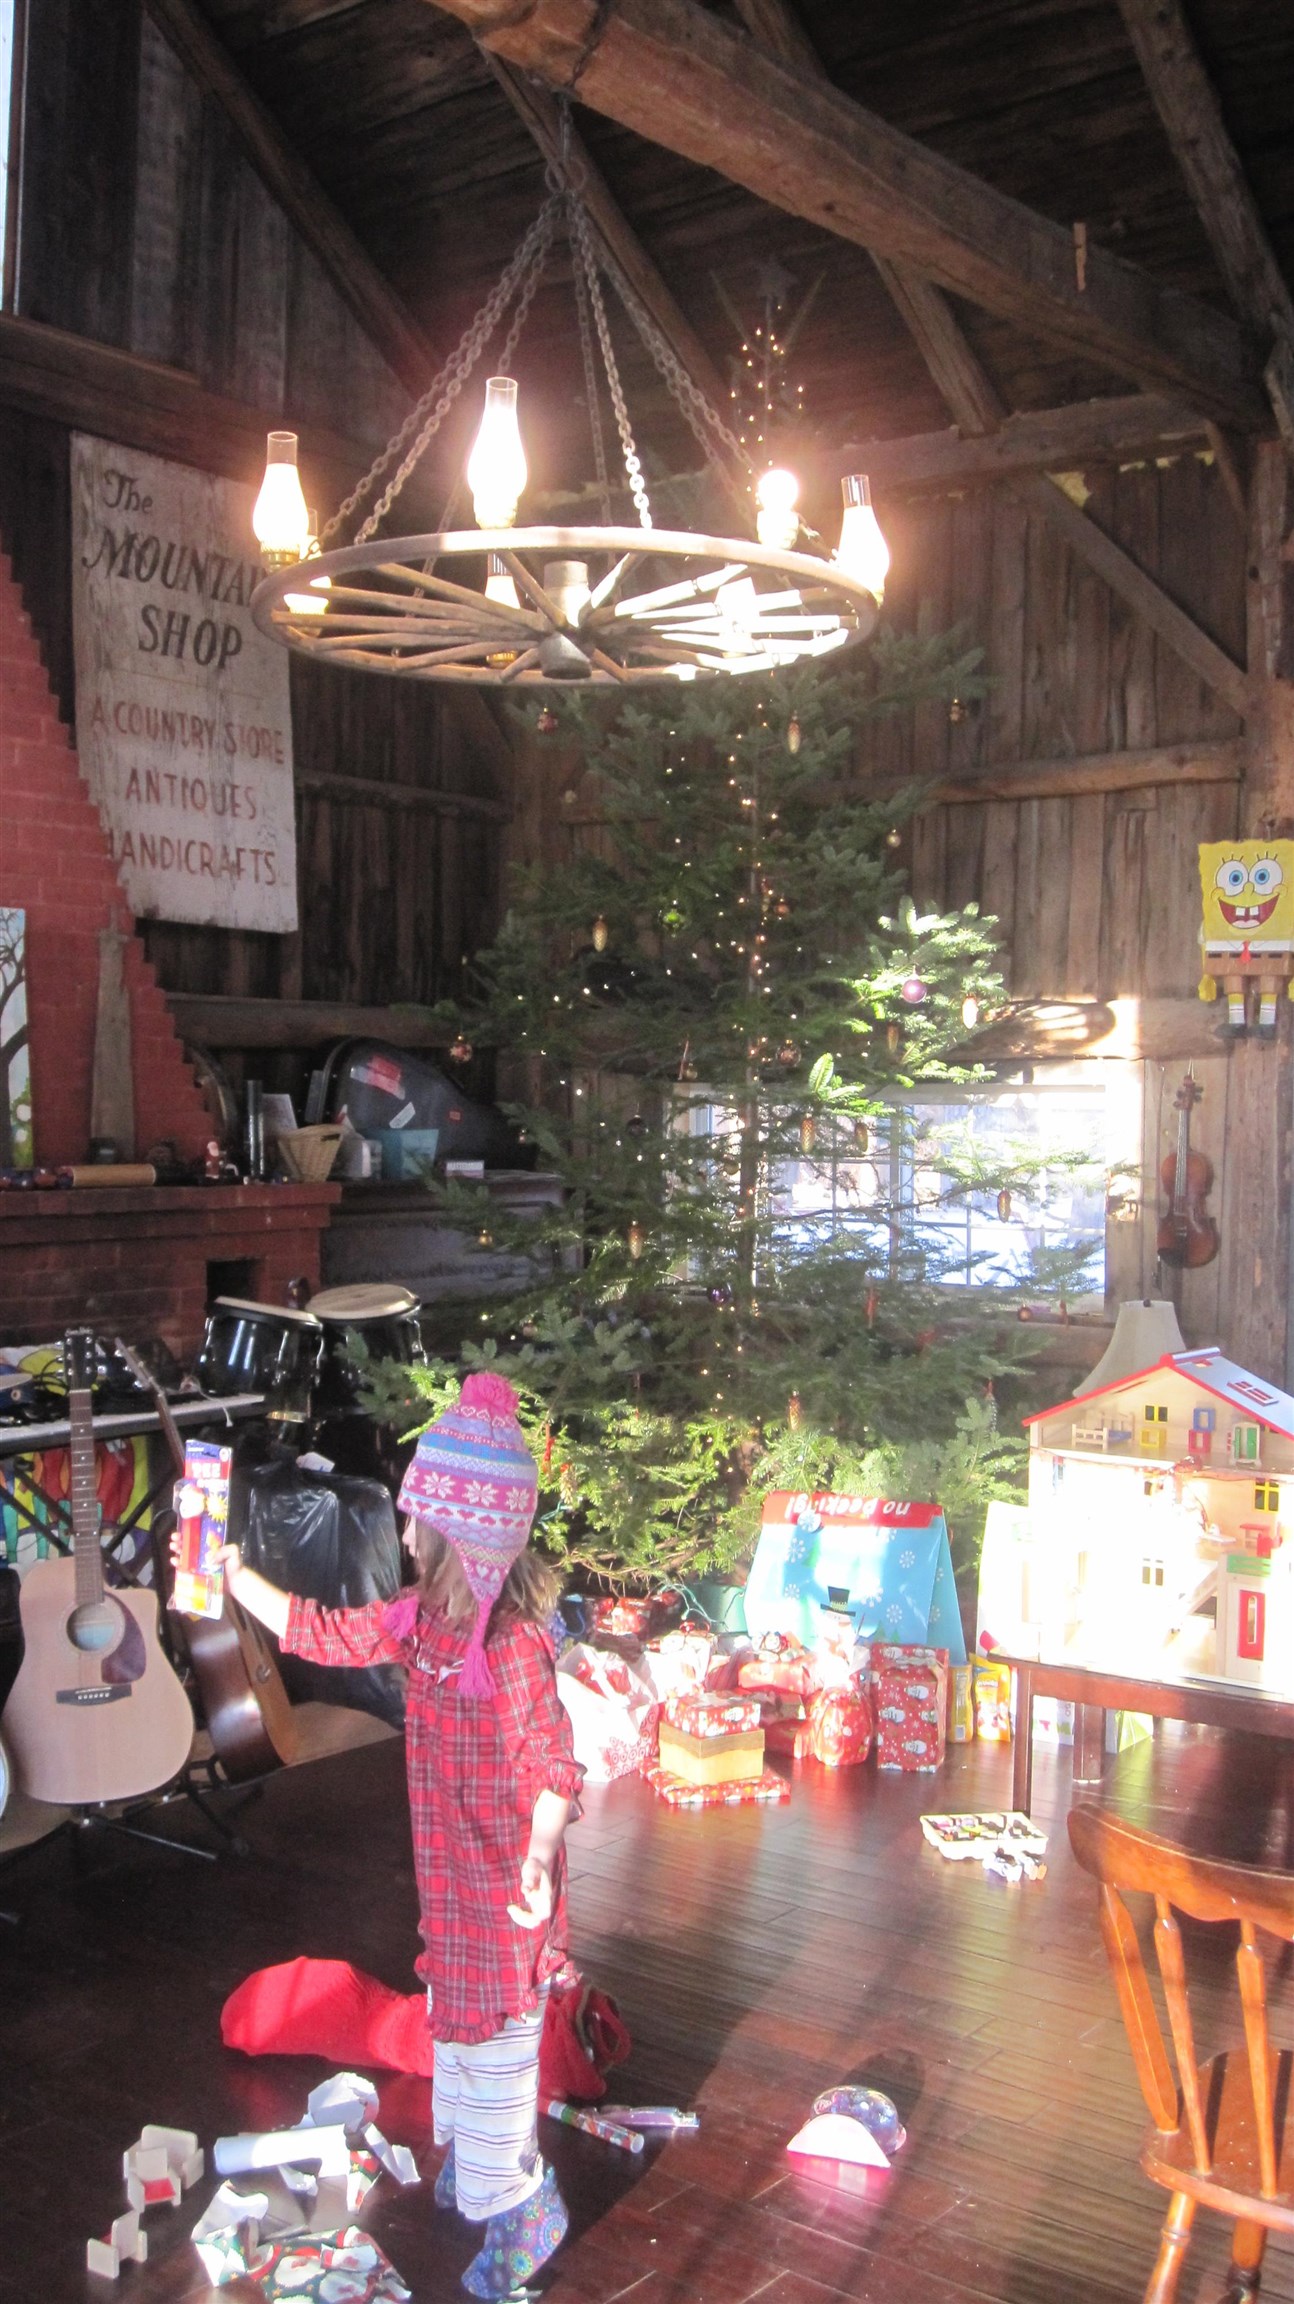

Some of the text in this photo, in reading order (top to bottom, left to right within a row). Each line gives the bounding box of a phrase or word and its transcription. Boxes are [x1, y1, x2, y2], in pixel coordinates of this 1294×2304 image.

[103, 469, 153, 514] The
[81, 526, 268, 608] MOUNTAI
[138, 604, 242, 669] SHOP
[91, 697, 284, 765] A COUNTRY STORE
[126, 767, 257, 820] ANTIQUES
[883, 1501, 911, 1516] no
